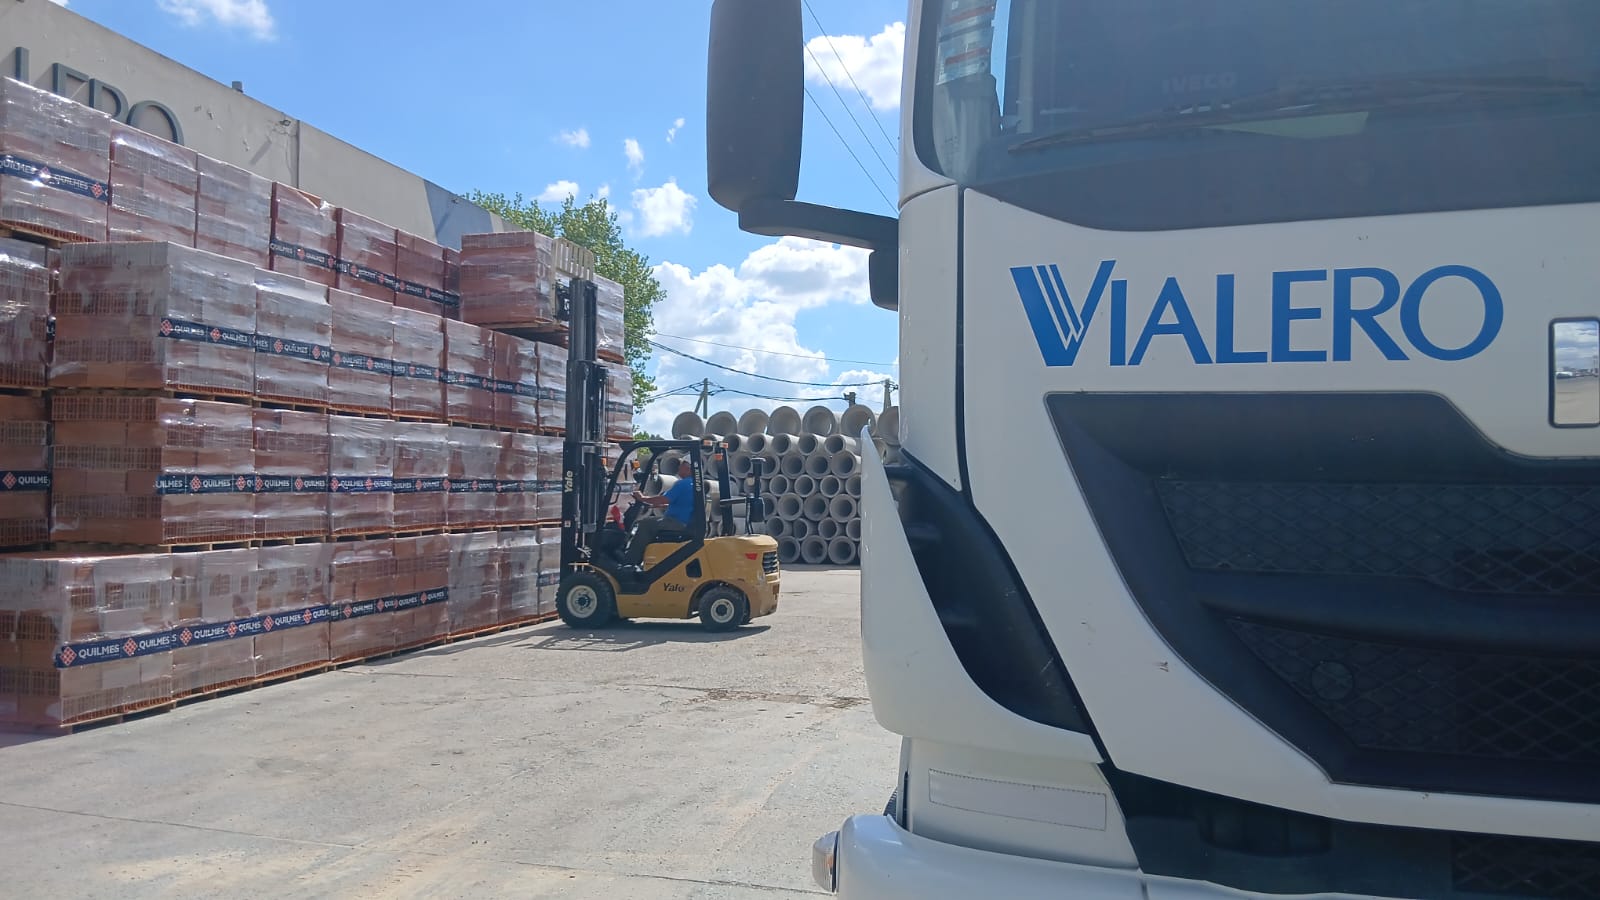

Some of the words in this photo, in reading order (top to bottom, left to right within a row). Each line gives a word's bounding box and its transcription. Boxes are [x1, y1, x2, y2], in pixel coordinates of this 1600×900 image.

[1161, 72, 1238, 95] IVECO
[1010, 260, 1503, 366] VIALERO
[18, 475, 49, 486] QUILME
[156, 480, 183, 489] UILMES
[203, 479, 231, 488] QUILMES
[264, 479, 290, 488] QUILMES
[564, 470, 573, 493] Yale
[663, 582, 685, 593] Yale
[194, 626, 225, 639] QUILMES
[275, 614, 301, 625] QUILMES
[78, 643, 119, 659] QUILMES
[139, 636, 170, 650] QUILMES
